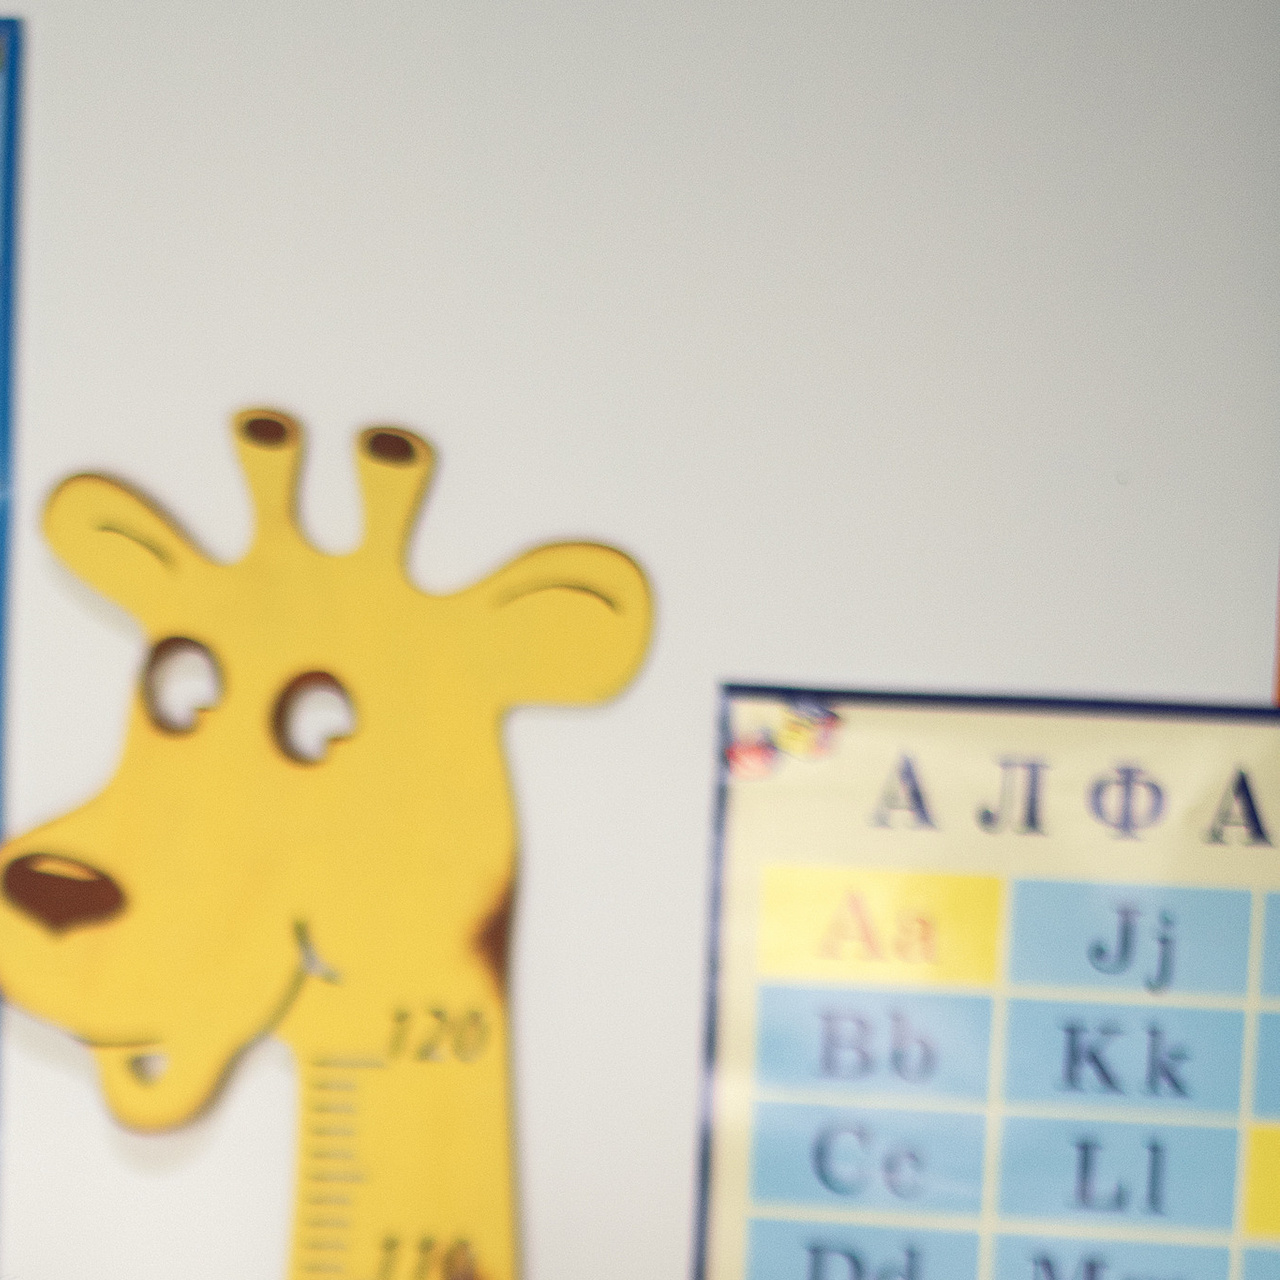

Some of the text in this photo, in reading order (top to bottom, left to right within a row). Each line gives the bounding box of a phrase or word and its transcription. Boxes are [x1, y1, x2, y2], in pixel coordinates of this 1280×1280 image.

[817, 884, 942, 968] Aa
[1086, 902, 1181, 996] Jj
[387, 1007, 490, 1063] 120
[818, 1005, 940, 1086] Bb
[1058, 1019, 1194, 1100] Kk
[809, 1119, 925, 1200] Cc
[1072, 1135, 1168, 1218] Ll
